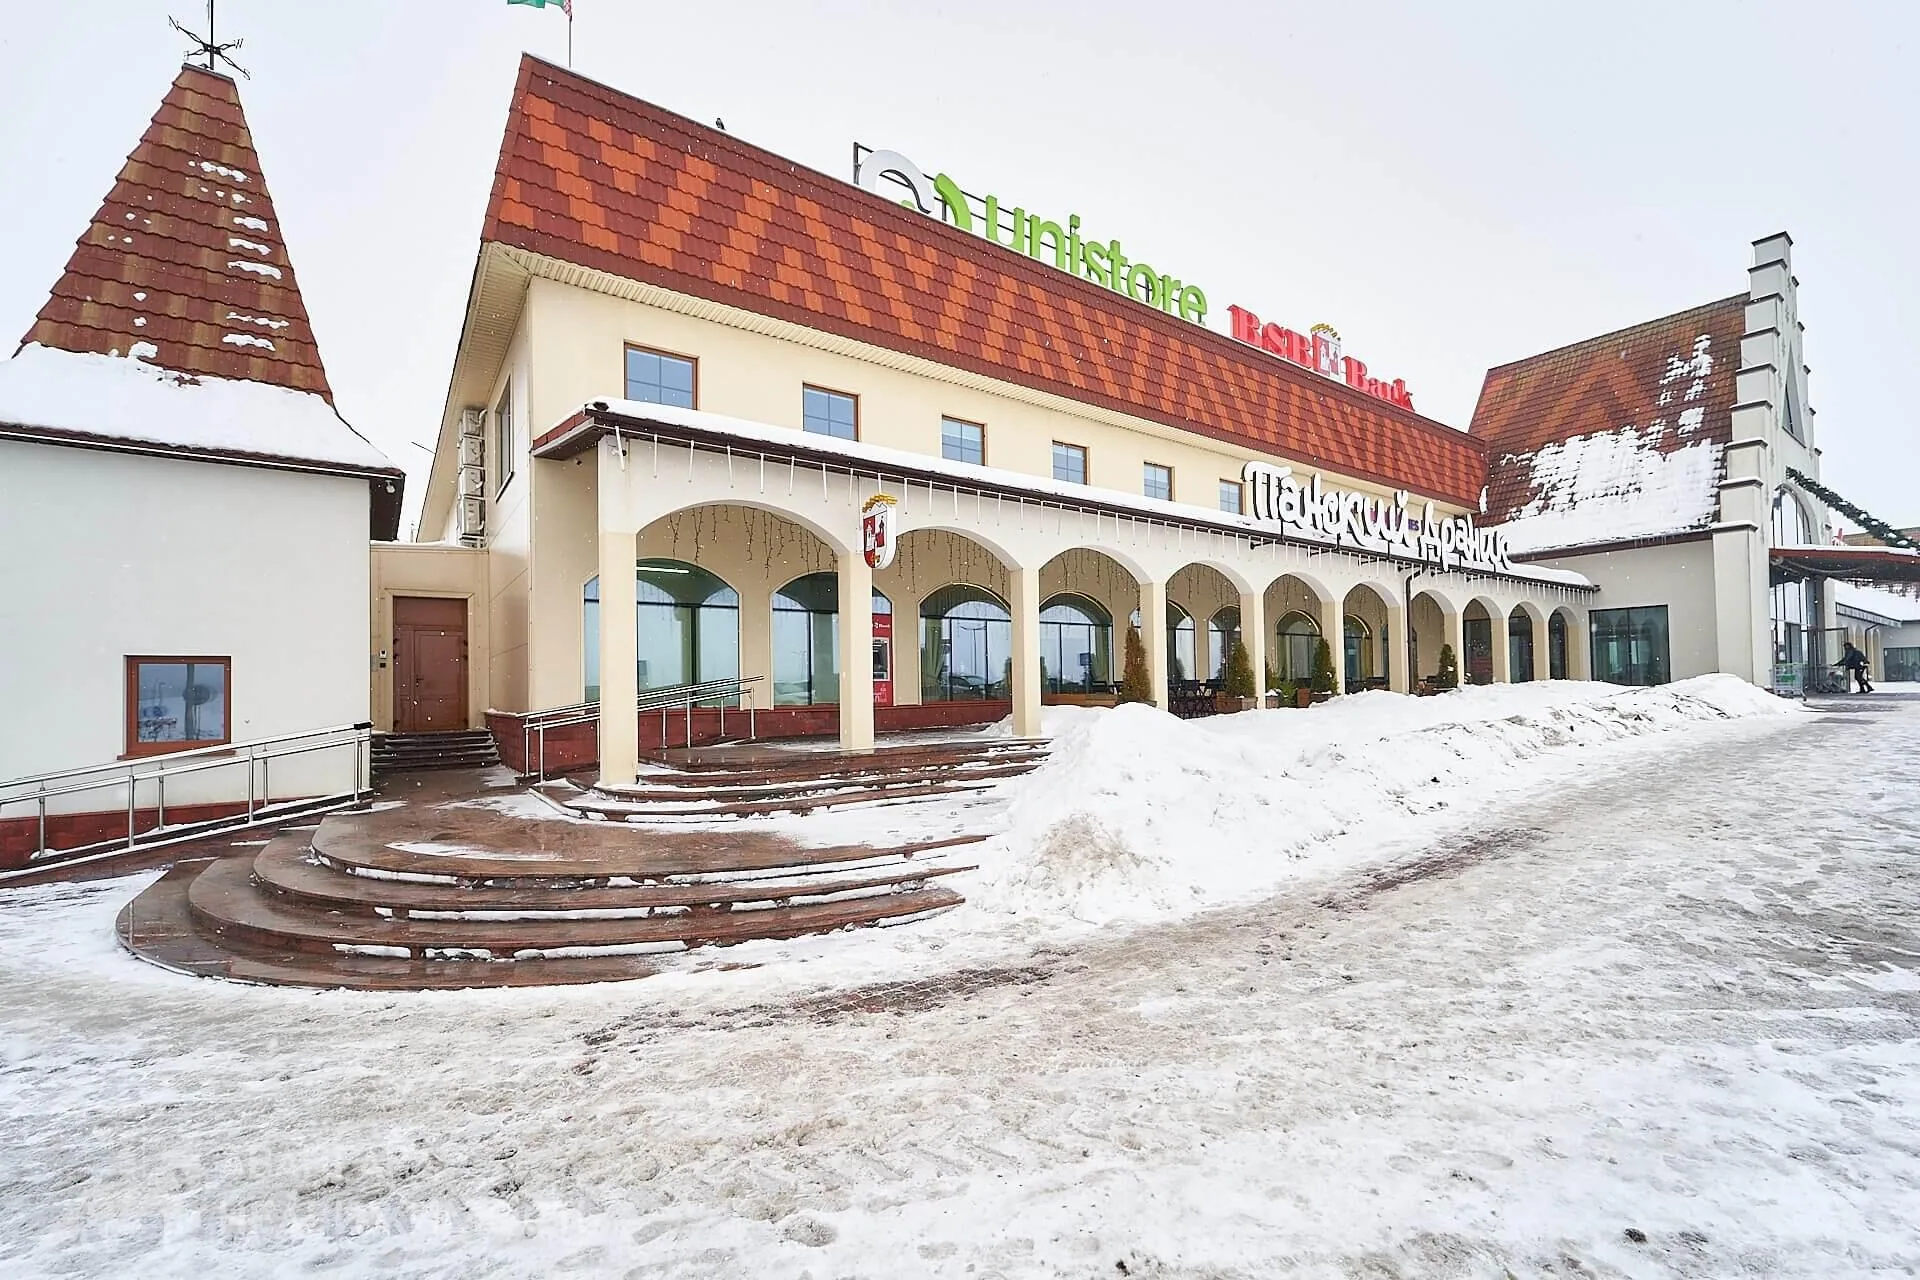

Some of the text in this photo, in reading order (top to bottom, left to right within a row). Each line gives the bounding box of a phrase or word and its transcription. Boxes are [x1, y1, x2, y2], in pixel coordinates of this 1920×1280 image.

[985, 195, 1208, 325] unistore
[1226, 304, 1415, 411] BSB Bank
